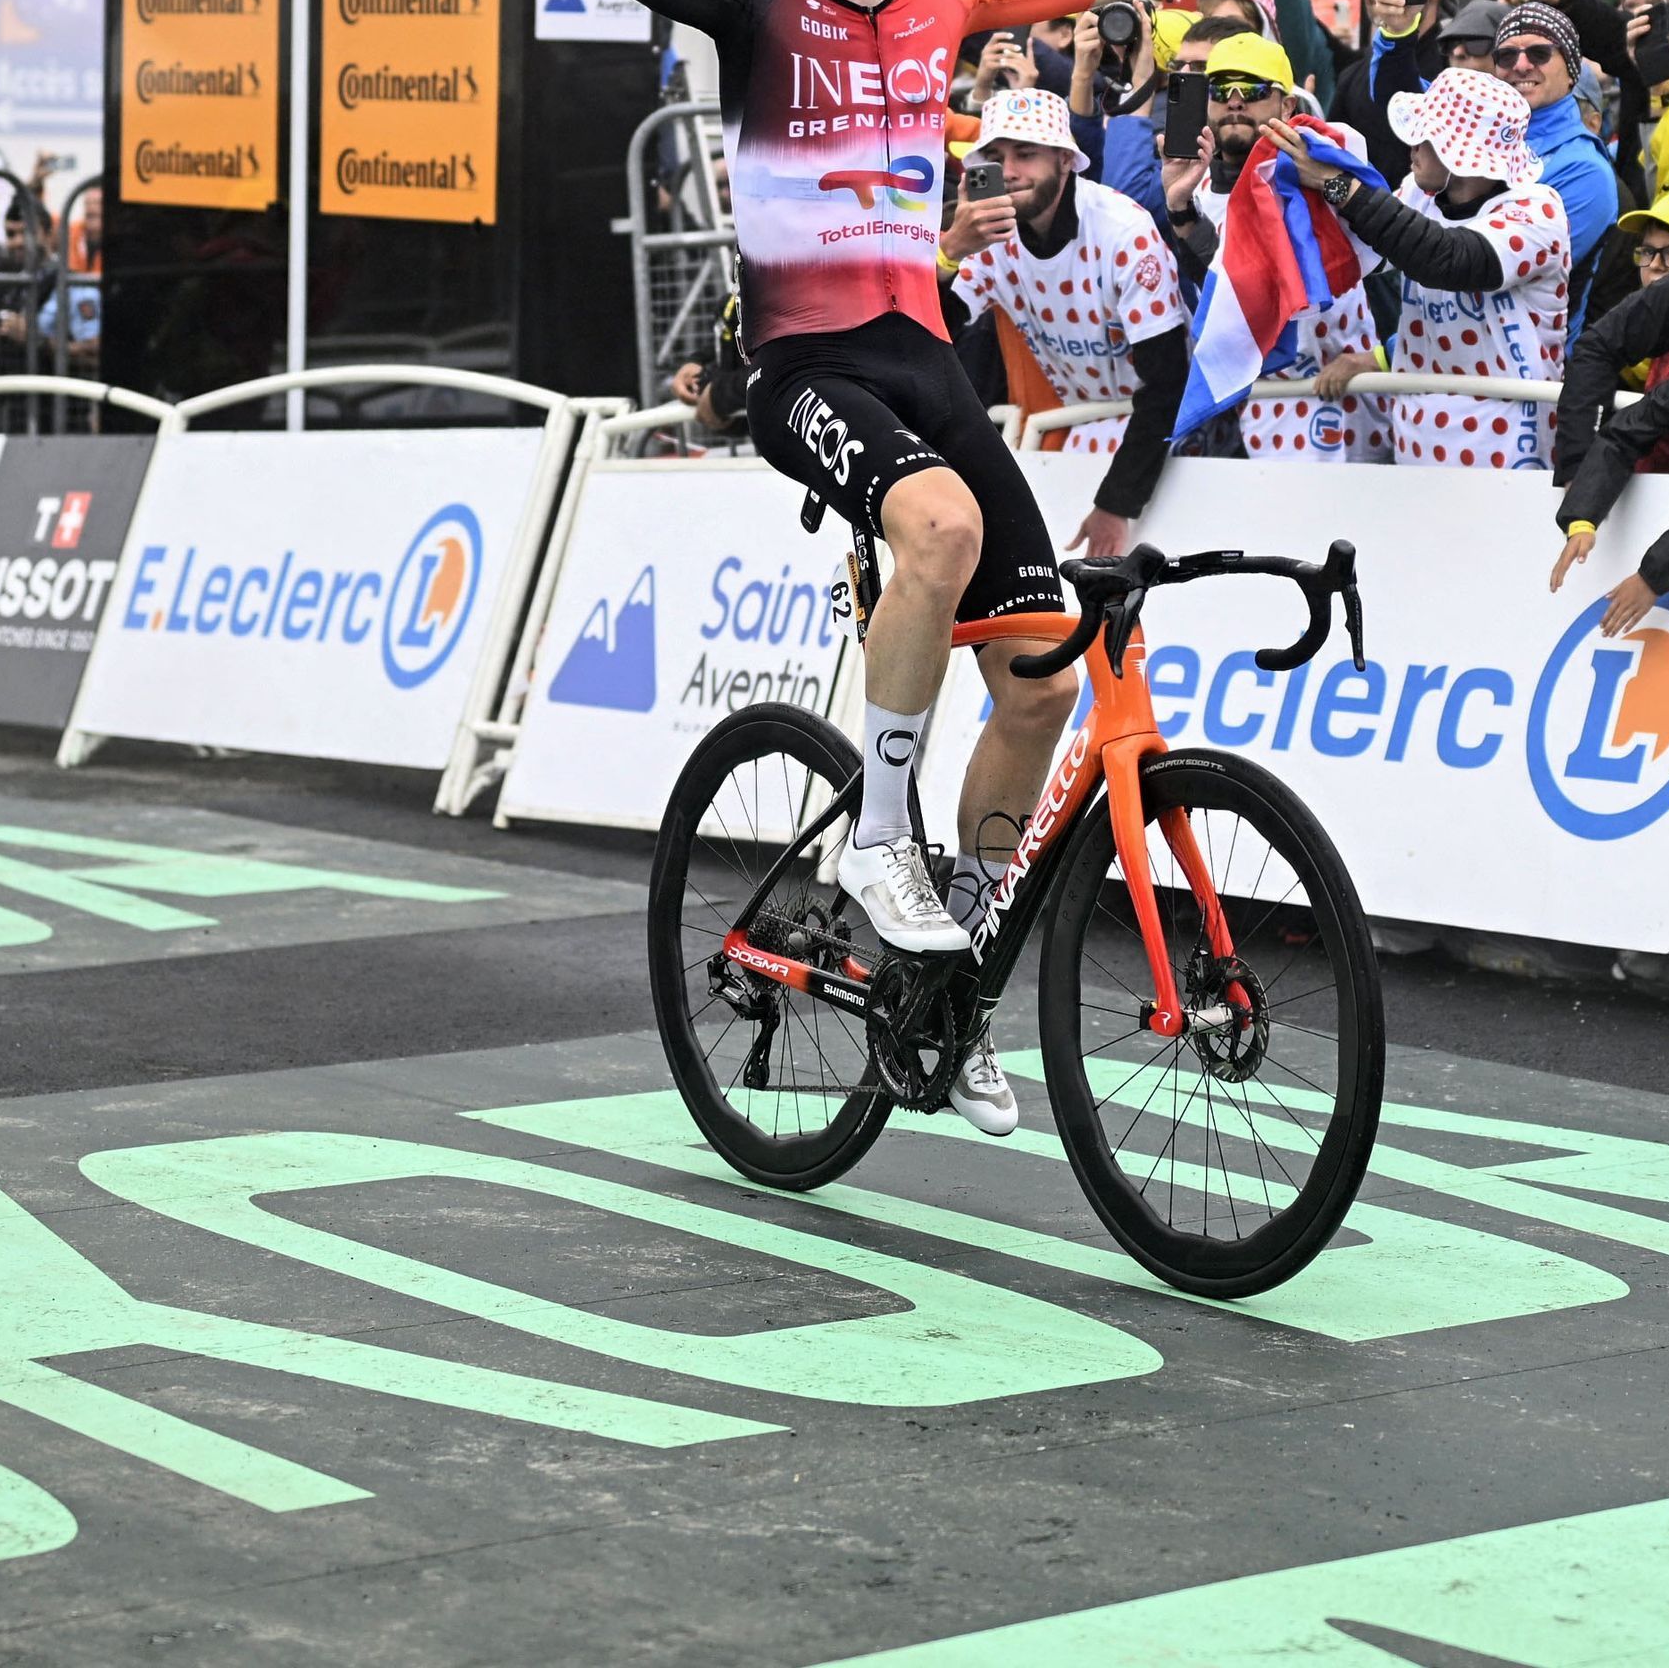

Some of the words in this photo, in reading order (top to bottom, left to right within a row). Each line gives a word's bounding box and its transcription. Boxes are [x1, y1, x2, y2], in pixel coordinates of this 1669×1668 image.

[801, 15, 848, 41] GOBIK
[136, 60, 243, 104] Continental
[338, 63, 458, 110] Continental
[790, 47, 948, 110] INEOS
[135, 139, 242, 183] Continental
[337, 148, 457, 194] Continental
[817, 220, 936, 246] TotalEnergies
[787, 387, 865, 486] INEOS
[1018, 565, 1054, 579] GOBIK
[124, 547, 382, 646] E.Leclerc
[831, 581, 852, 623] 62
[681, 652, 822, 713] Aventin
[1164, 759, 1186, 769] PRIX
[1185, 758, 1210, 767] 5000
[727, 945, 790, 978] DOGMA
[823, 983, 865, 1008] SHIMANO
